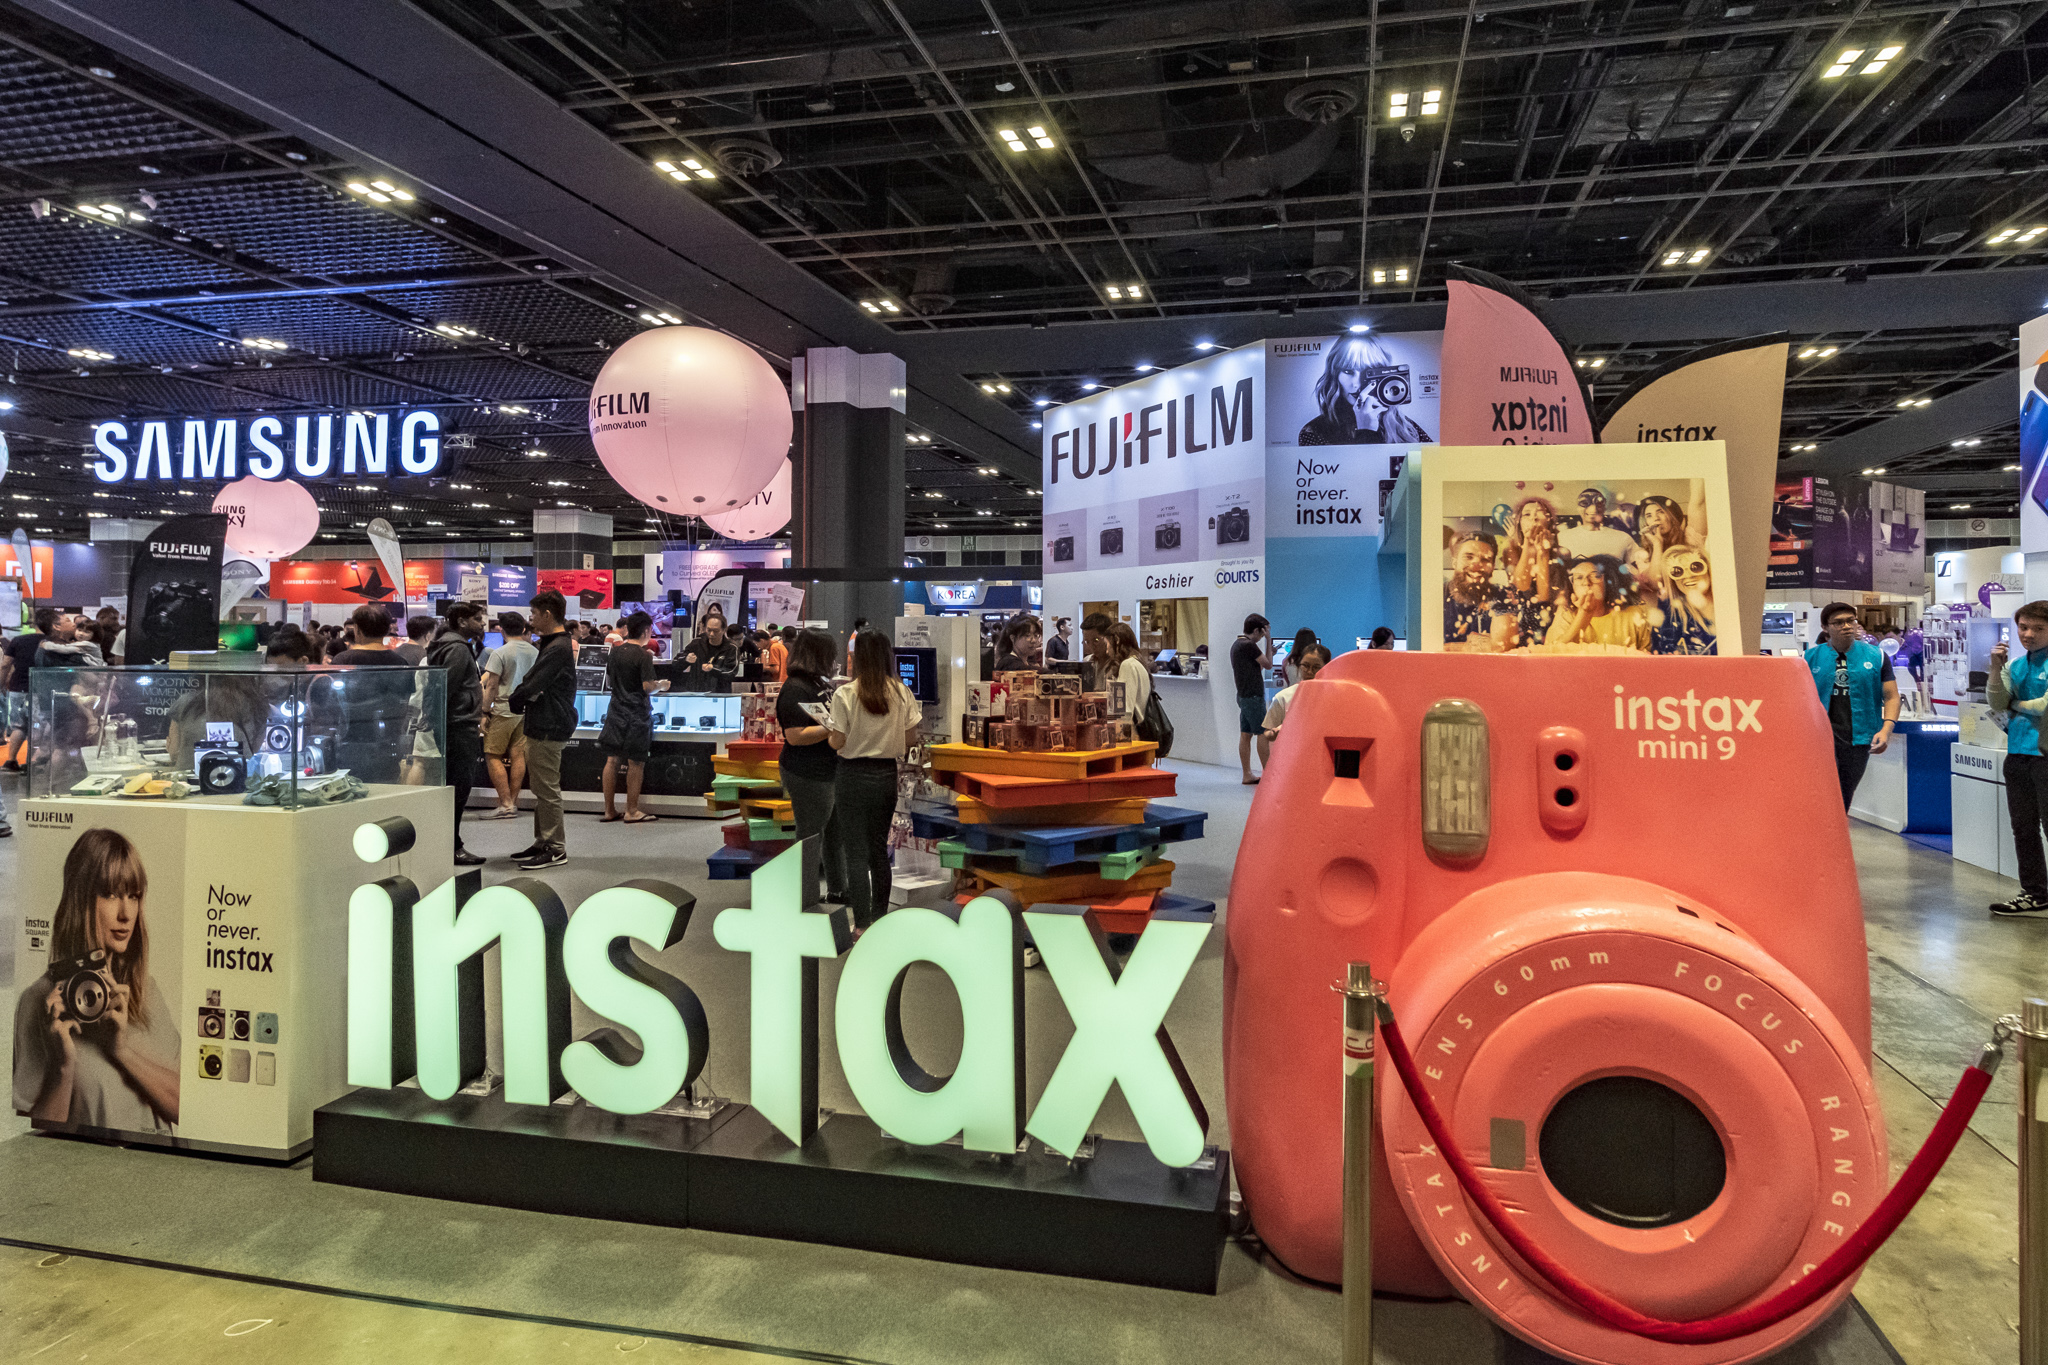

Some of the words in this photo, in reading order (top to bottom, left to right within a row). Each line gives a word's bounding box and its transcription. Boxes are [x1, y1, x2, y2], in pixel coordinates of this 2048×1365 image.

[1274, 342, 1321, 353] FUJIFILM
[600, 420, 647, 432] Innovation
[1051, 377, 1253, 484] FUJIFILM
[1638, 424, 1717, 443] instax
[94, 411, 440, 483] SAMSUNG
[1297, 459, 1340, 475] Now
[1296, 477, 1314, 488] or
[1297, 487, 1349, 501] never.
[1296, 504, 1362, 525] instax
[150, 541, 211, 556] FUJIFILM
[1146, 573, 1194, 590] Cashier
[1216, 569, 1260, 584] COURTS
[937, 589, 976, 600] KOREA
[147, 677, 200, 688] HOOTING
[1614, 684, 1763, 733] instax
[1638, 734, 1708, 760] mini
[1717, 736, 1736, 760] 9
[1954, 753, 1993, 770] SAMSUNG
[26, 811, 73, 824] FUJIFILM
[207, 884, 252, 907] Now
[25, 916, 50, 929] instax
[207, 908, 226, 921] or
[25, 929, 50, 937] SQUARE
[207, 924, 260, 941] never.
[206, 941, 274, 973] instax
[347, 823, 1215, 1169] instax
[1674, 960, 1804, 1055] FOCUS
[1425, 1012, 1475, 1086] ENS
[1820, 1094, 1854, 1237] RANGE
[1418, 1142, 1510, 1291] INSTAX
